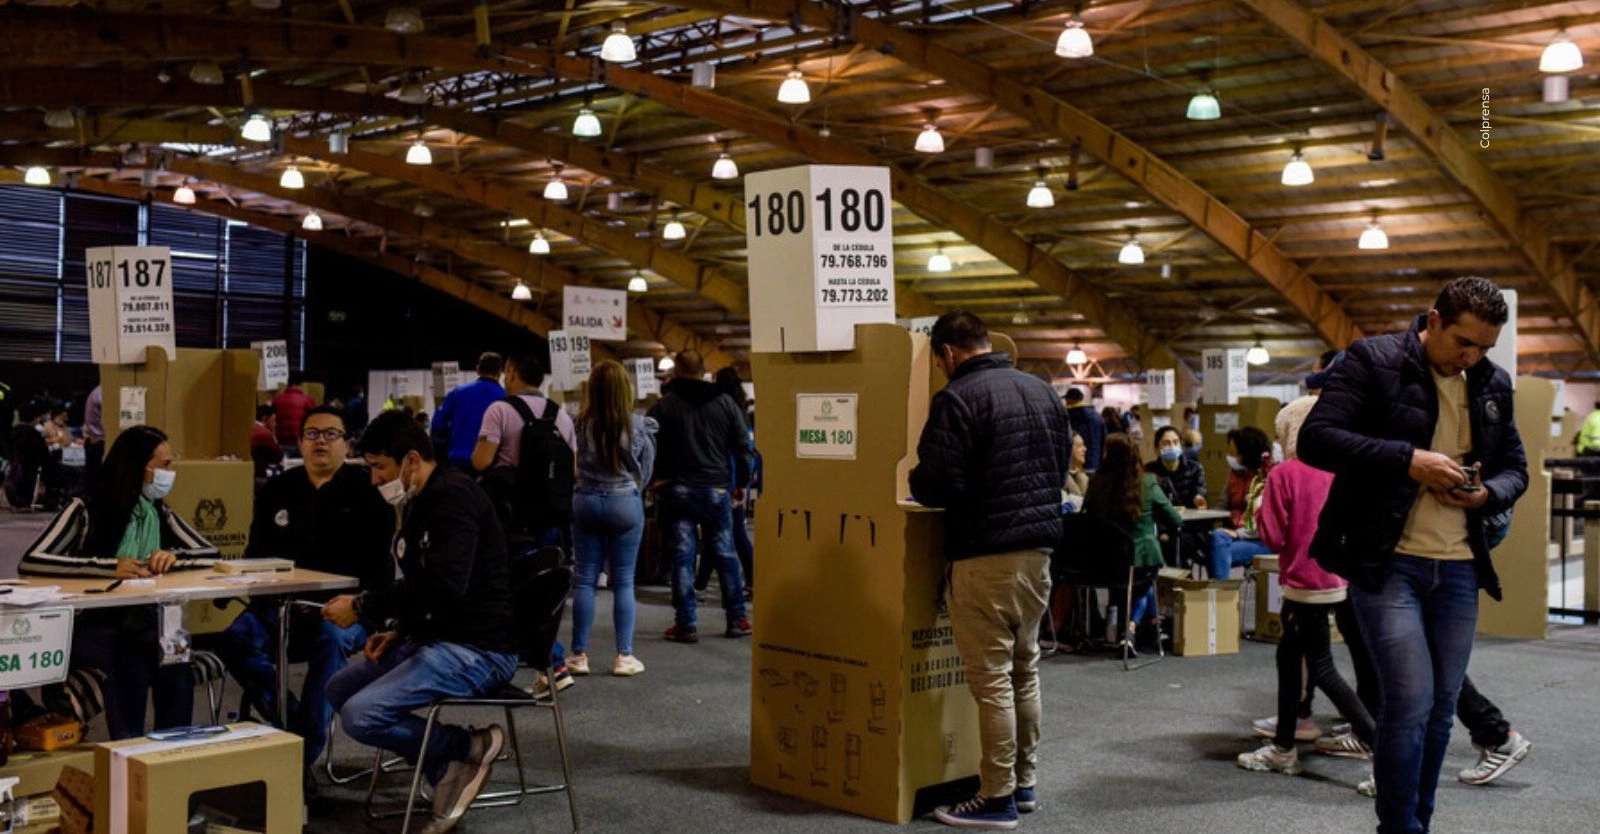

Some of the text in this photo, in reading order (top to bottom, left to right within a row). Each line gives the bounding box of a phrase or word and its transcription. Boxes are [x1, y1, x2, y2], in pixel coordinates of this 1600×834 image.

[748, 190, 805, 237] 180
[816, 188, 885, 232] 180
[820, 254, 888, 268] 79.768.796
[88, 260, 112, 289] 187
[117, 258, 166, 288] 187
[821, 288, 889, 302] 79.773.202
[568, 315, 603, 328] SALIDA
[551, 337, 568, 352] 193
[571, 336, 590, 352] 193
[1207, 355, 1224, 369] 185
[800, 429, 853, 444] MESA 180
[29, 649, 64, 669] 180
